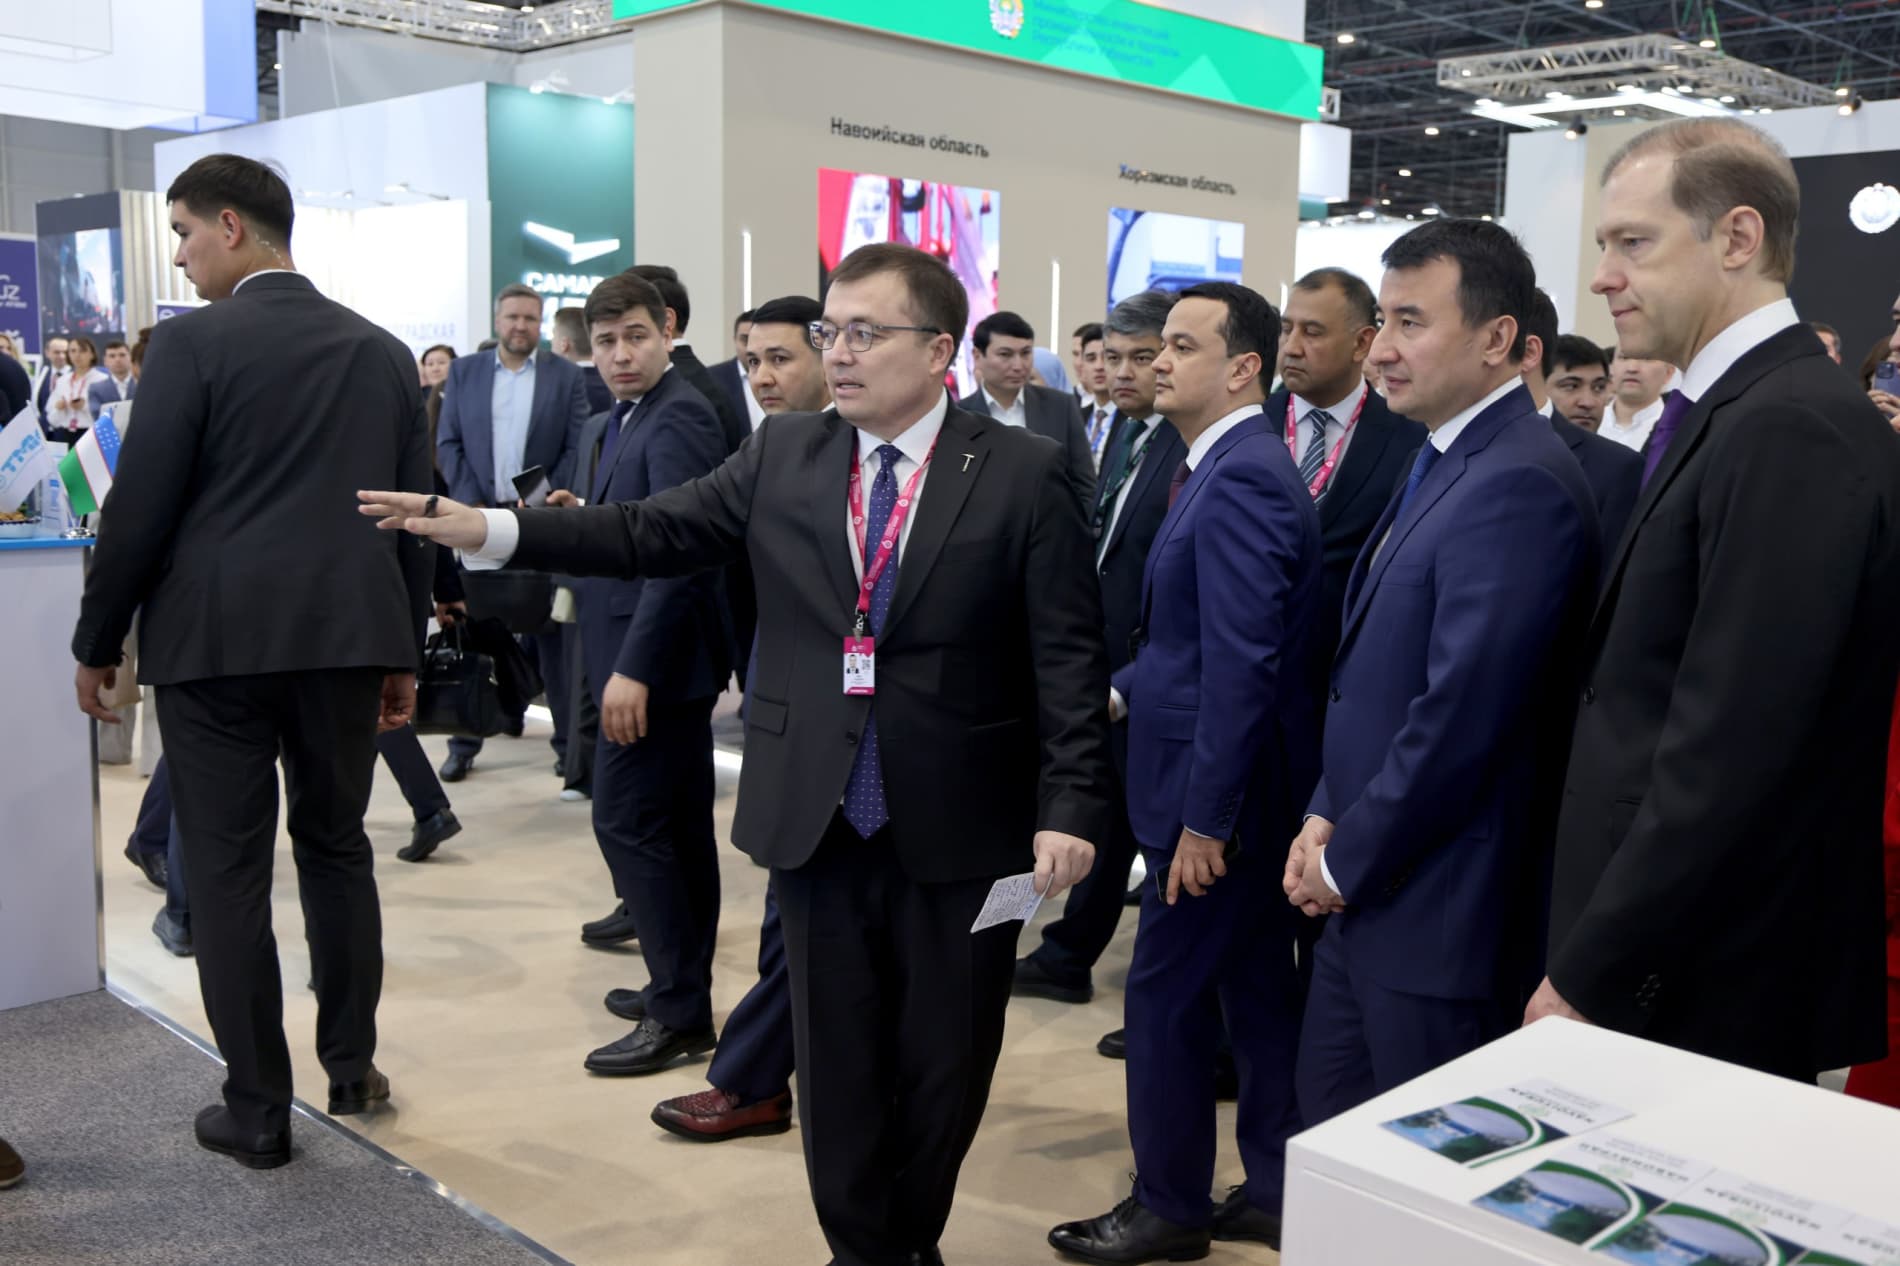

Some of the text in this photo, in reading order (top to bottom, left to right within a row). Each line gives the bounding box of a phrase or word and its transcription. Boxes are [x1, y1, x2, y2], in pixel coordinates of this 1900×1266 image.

[830, 116, 989, 158] Навоийская область
[525, 272, 605, 295] САМАР
